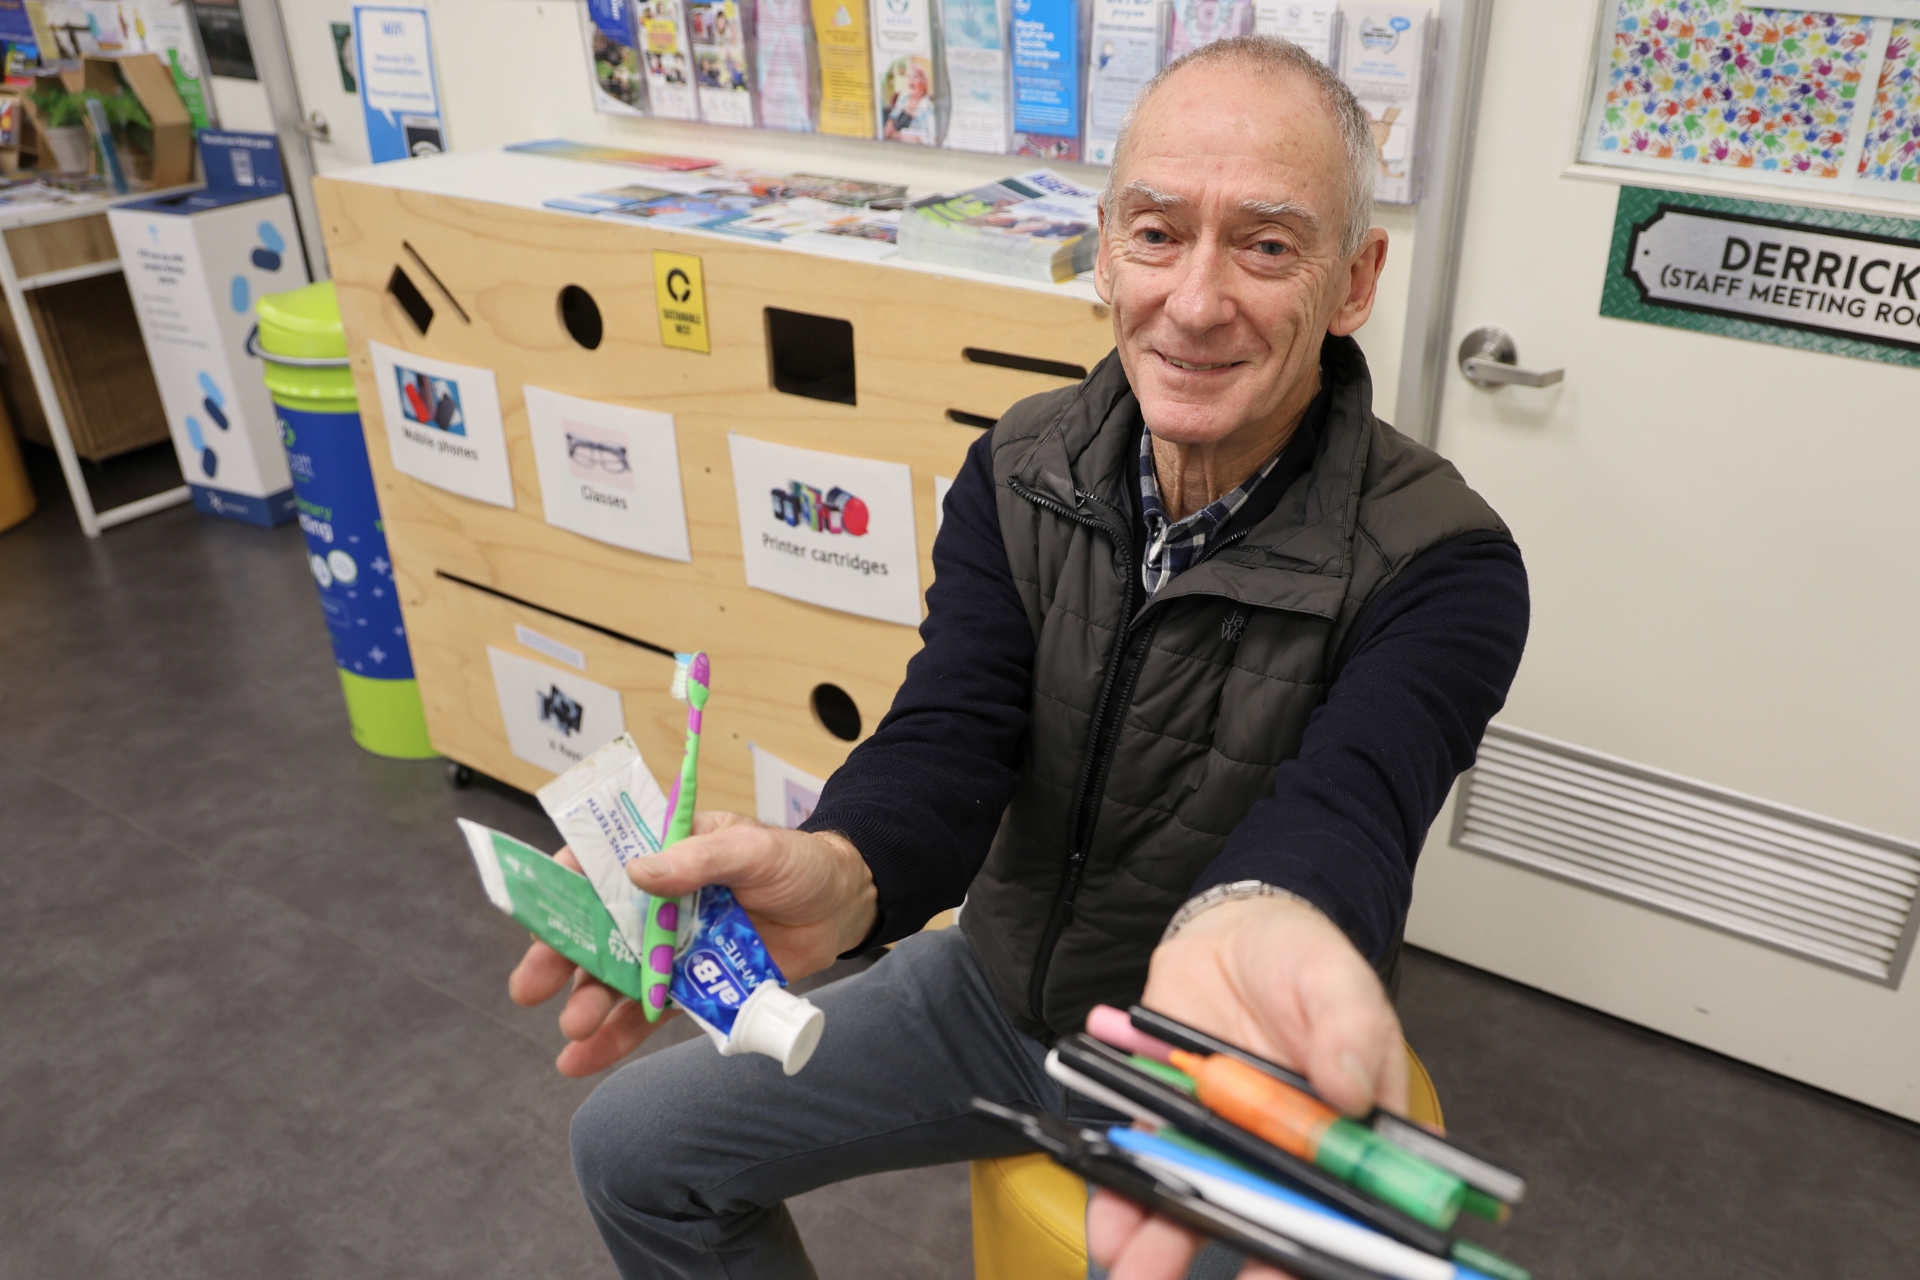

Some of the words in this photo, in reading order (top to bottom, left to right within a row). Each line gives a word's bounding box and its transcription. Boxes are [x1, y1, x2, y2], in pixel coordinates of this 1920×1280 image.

[1721, 236, 1920, 300] DERRICK
[1660, 264, 1743, 296] (STAFF
[1749, 281, 1867, 319] MEETING
[438, 440, 479, 461] phones
[581, 485, 628, 511] Glasses
[762, 532, 806, 558] Printer
[811, 548, 889, 576] cartridges
[587, 797, 612, 836] TEETH
[624, 844, 635, 854] 7
[545, 916, 573, 936] MINT
[569, 930, 599, 953] MILD
